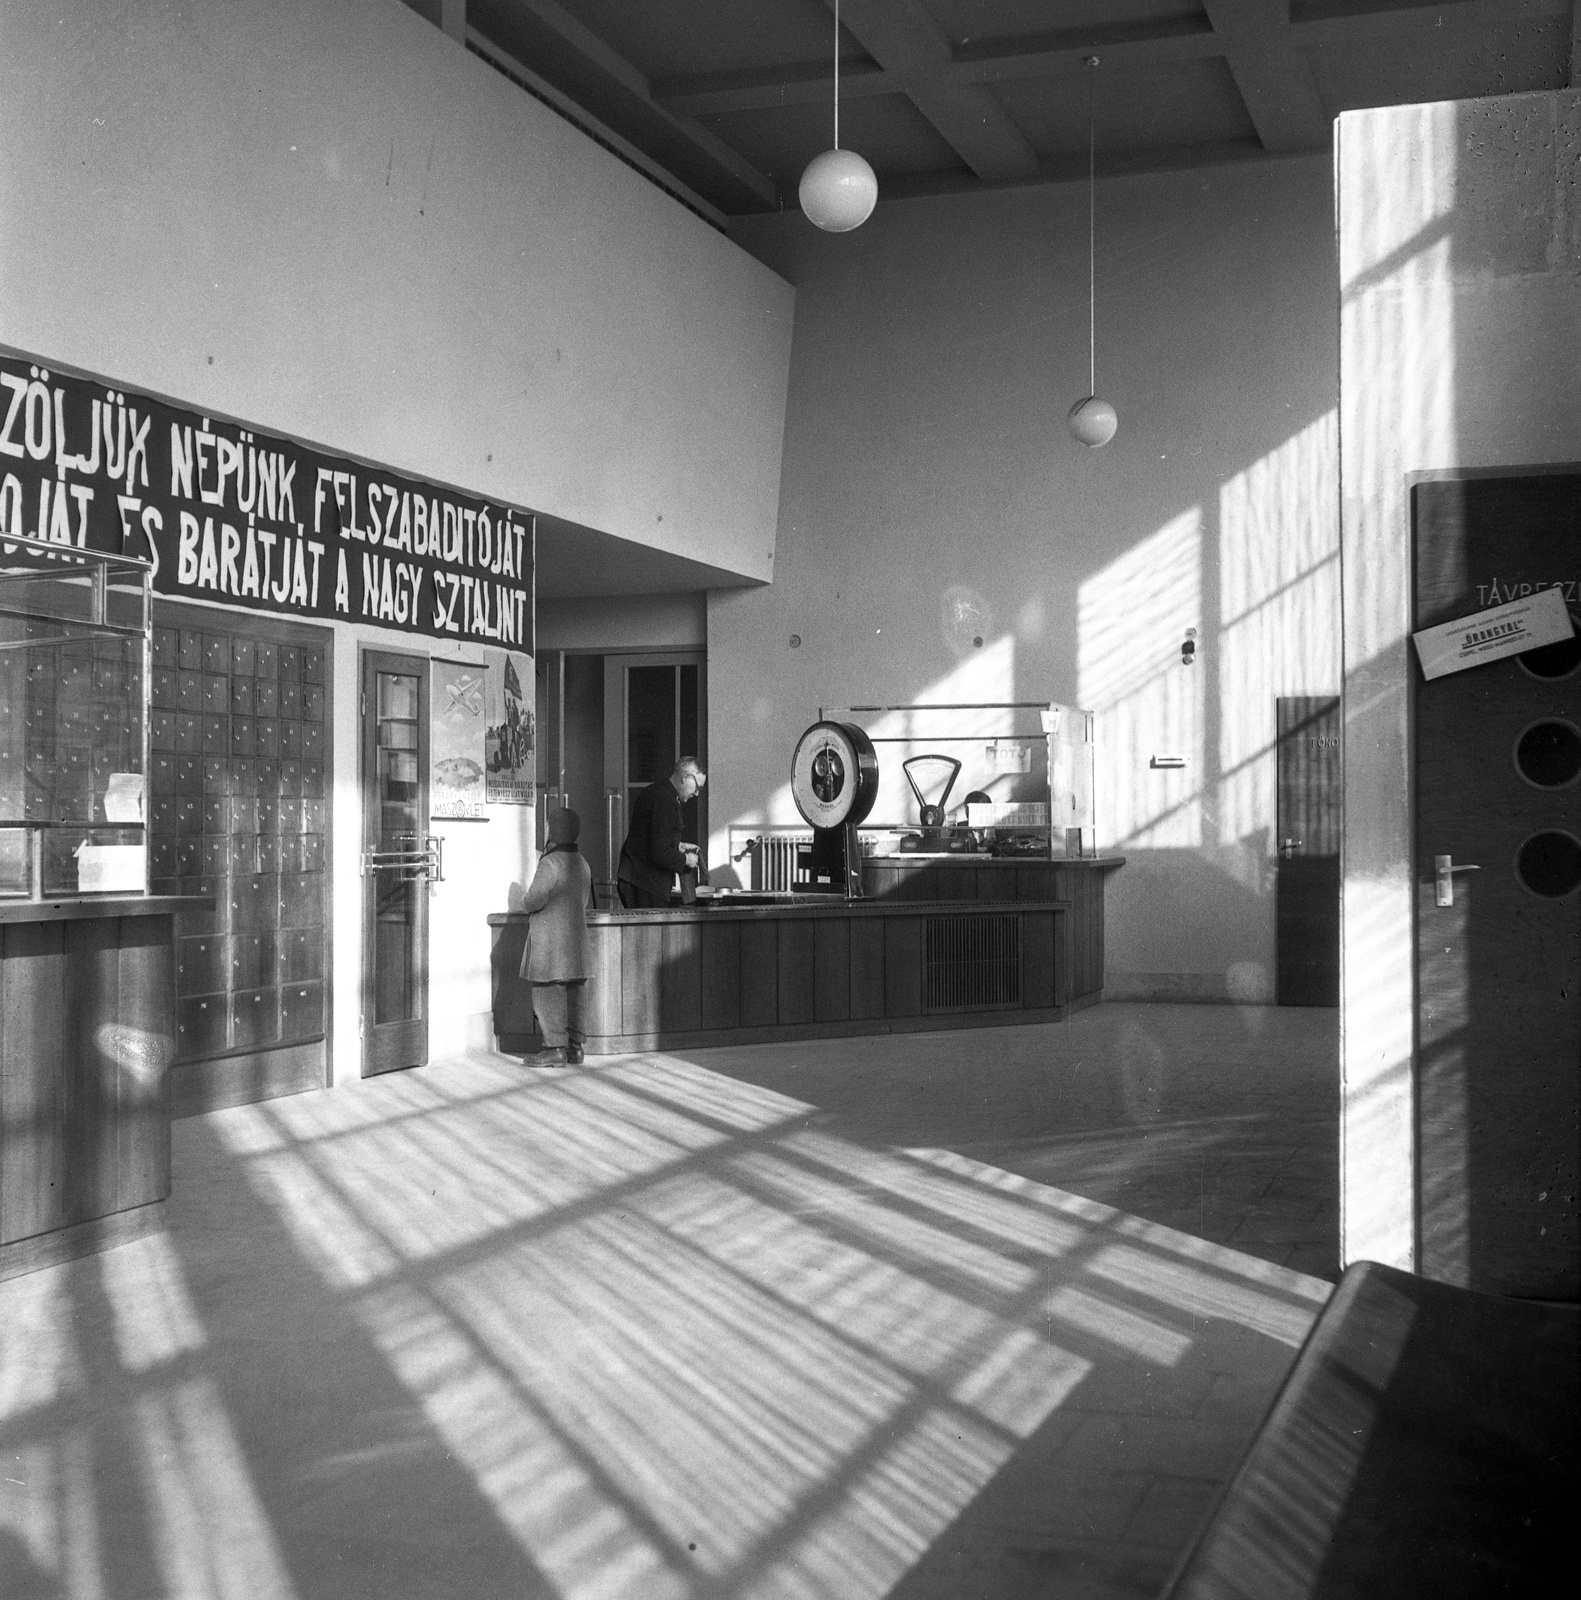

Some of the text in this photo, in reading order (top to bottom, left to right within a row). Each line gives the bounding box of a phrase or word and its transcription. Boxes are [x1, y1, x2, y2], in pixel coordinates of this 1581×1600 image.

[171, 417, 296, 524] NÉPÜNK
[315, 467, 525, 580] FELSZABADITÓJÁT
[178, 511, 325, 608] BARÁTJÁT
[335, 547, 350, 613] A
[362, 552, 423, 626] NAGY
[433, 570, 526, 645] SZTALINT
